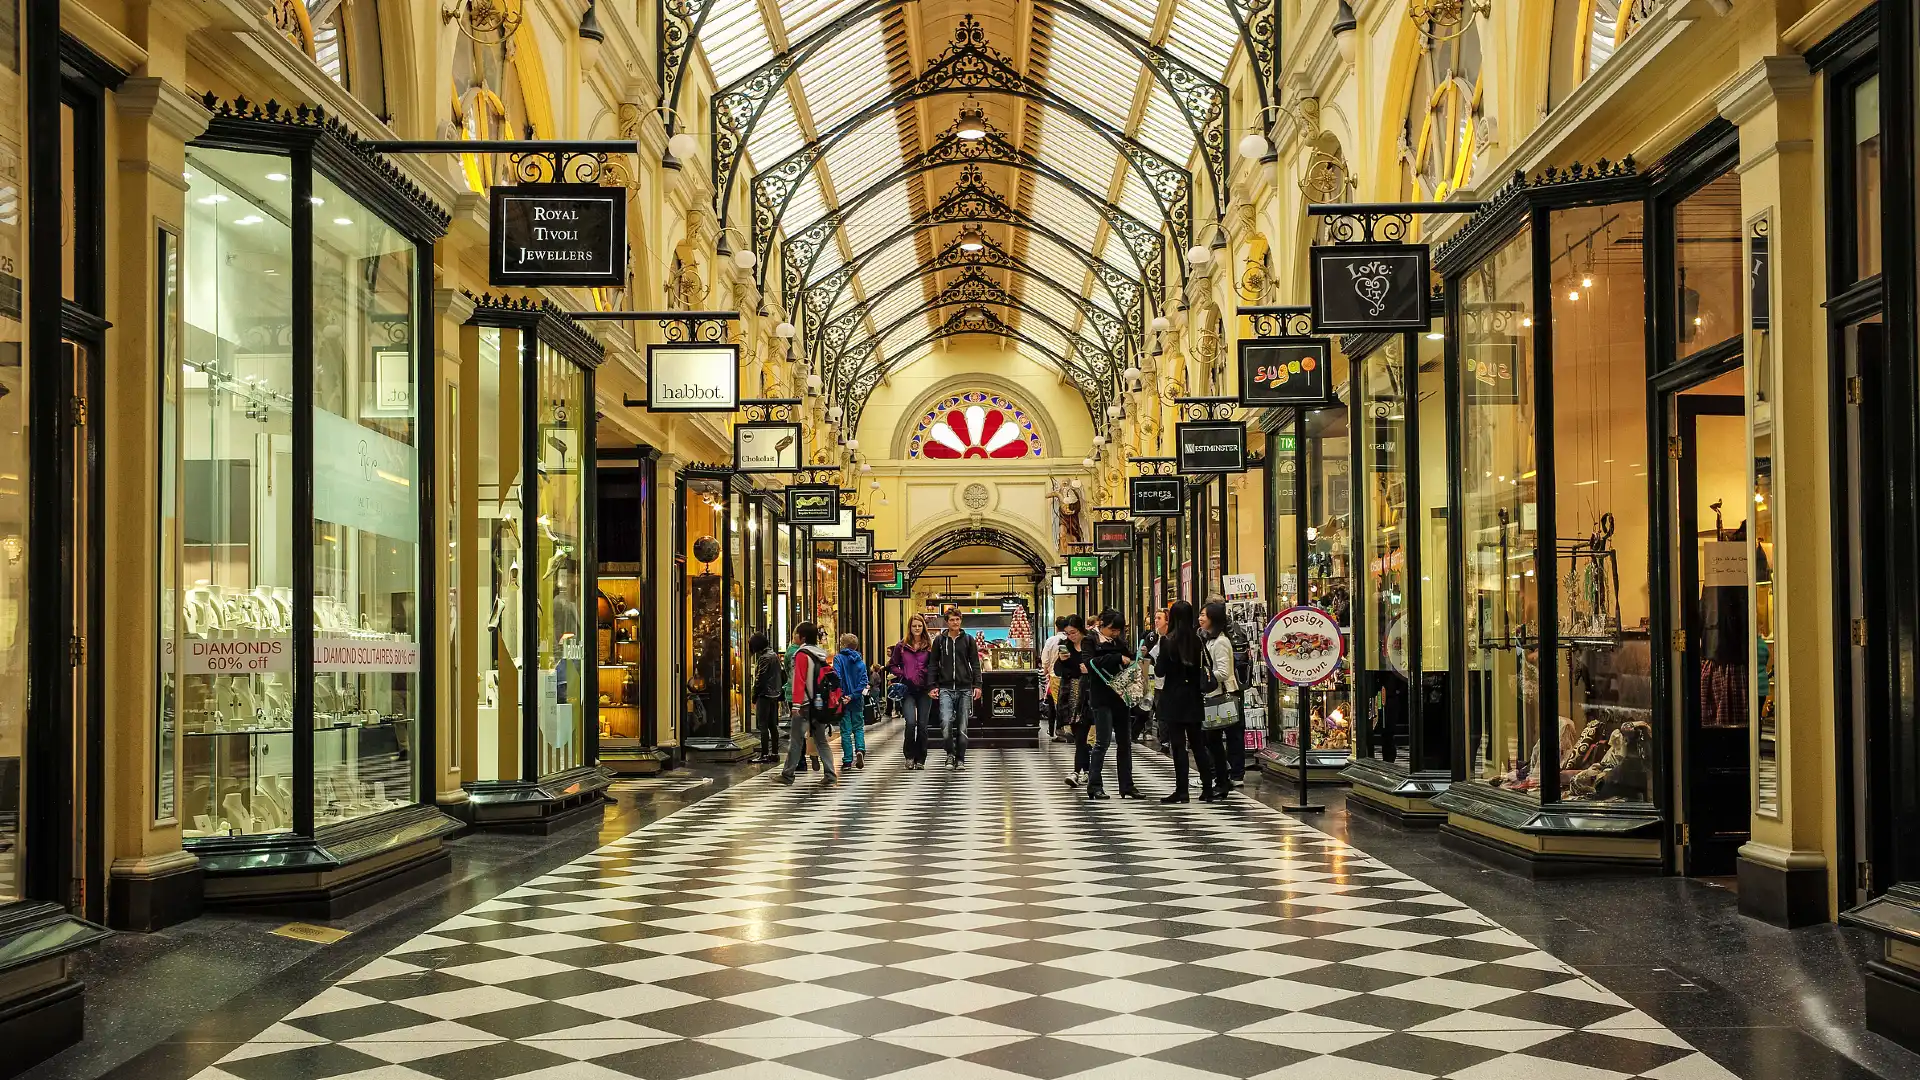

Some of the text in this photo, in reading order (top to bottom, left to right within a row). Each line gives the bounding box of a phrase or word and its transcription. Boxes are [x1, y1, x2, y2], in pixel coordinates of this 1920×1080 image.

[534, 207, 579, 220] ROYAL
[534, 227, 578, 240] TIVOLI
[519, 247, 593, 264] JEWELLERS
[1366, 288, 1382, 299] IT
[662, 384, 724, 399] habbot.
[1184, 444, 1239, 454] WESTMINSTER
[1138, 490, 1172, 498] SECRETS
[1282, 613, 1324, 629] Design
[193, 642, 282, 655] DIAMONDS
[323, 647, 357, 664] DIAMOND
[357, 648, 394, 664] SOLITAIRES
[207, 656, 269, 670] 60% off
[1277, 660, 1328, 677] your own
